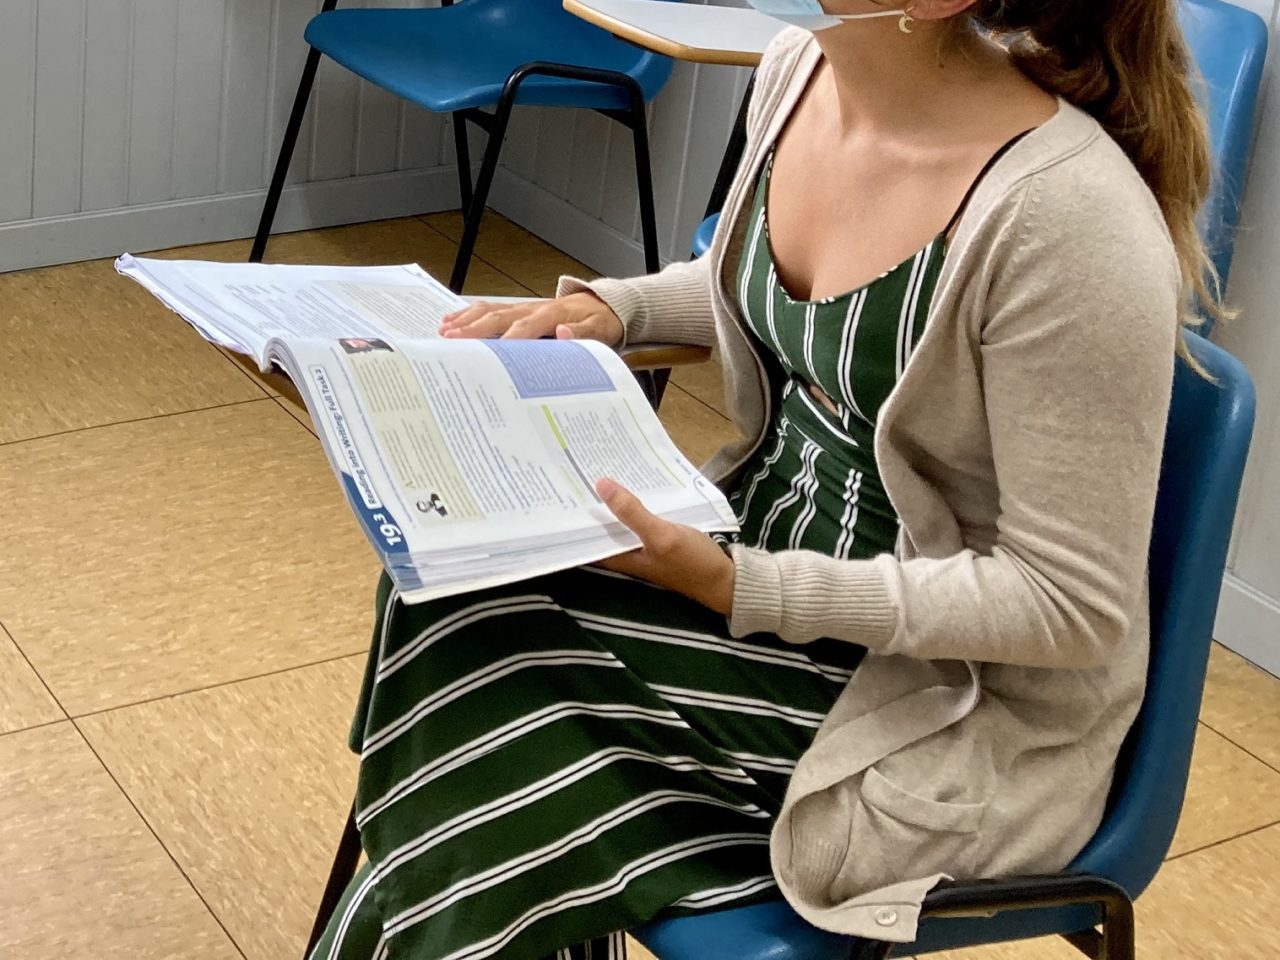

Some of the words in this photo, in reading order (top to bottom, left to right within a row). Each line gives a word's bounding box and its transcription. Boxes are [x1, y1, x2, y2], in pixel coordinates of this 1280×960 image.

[317, 375, 330, 395] Task
[324, 394, 337, 411] Full
[348, 449, 360, 468] into
[355, 469, 377, 505] Reading
